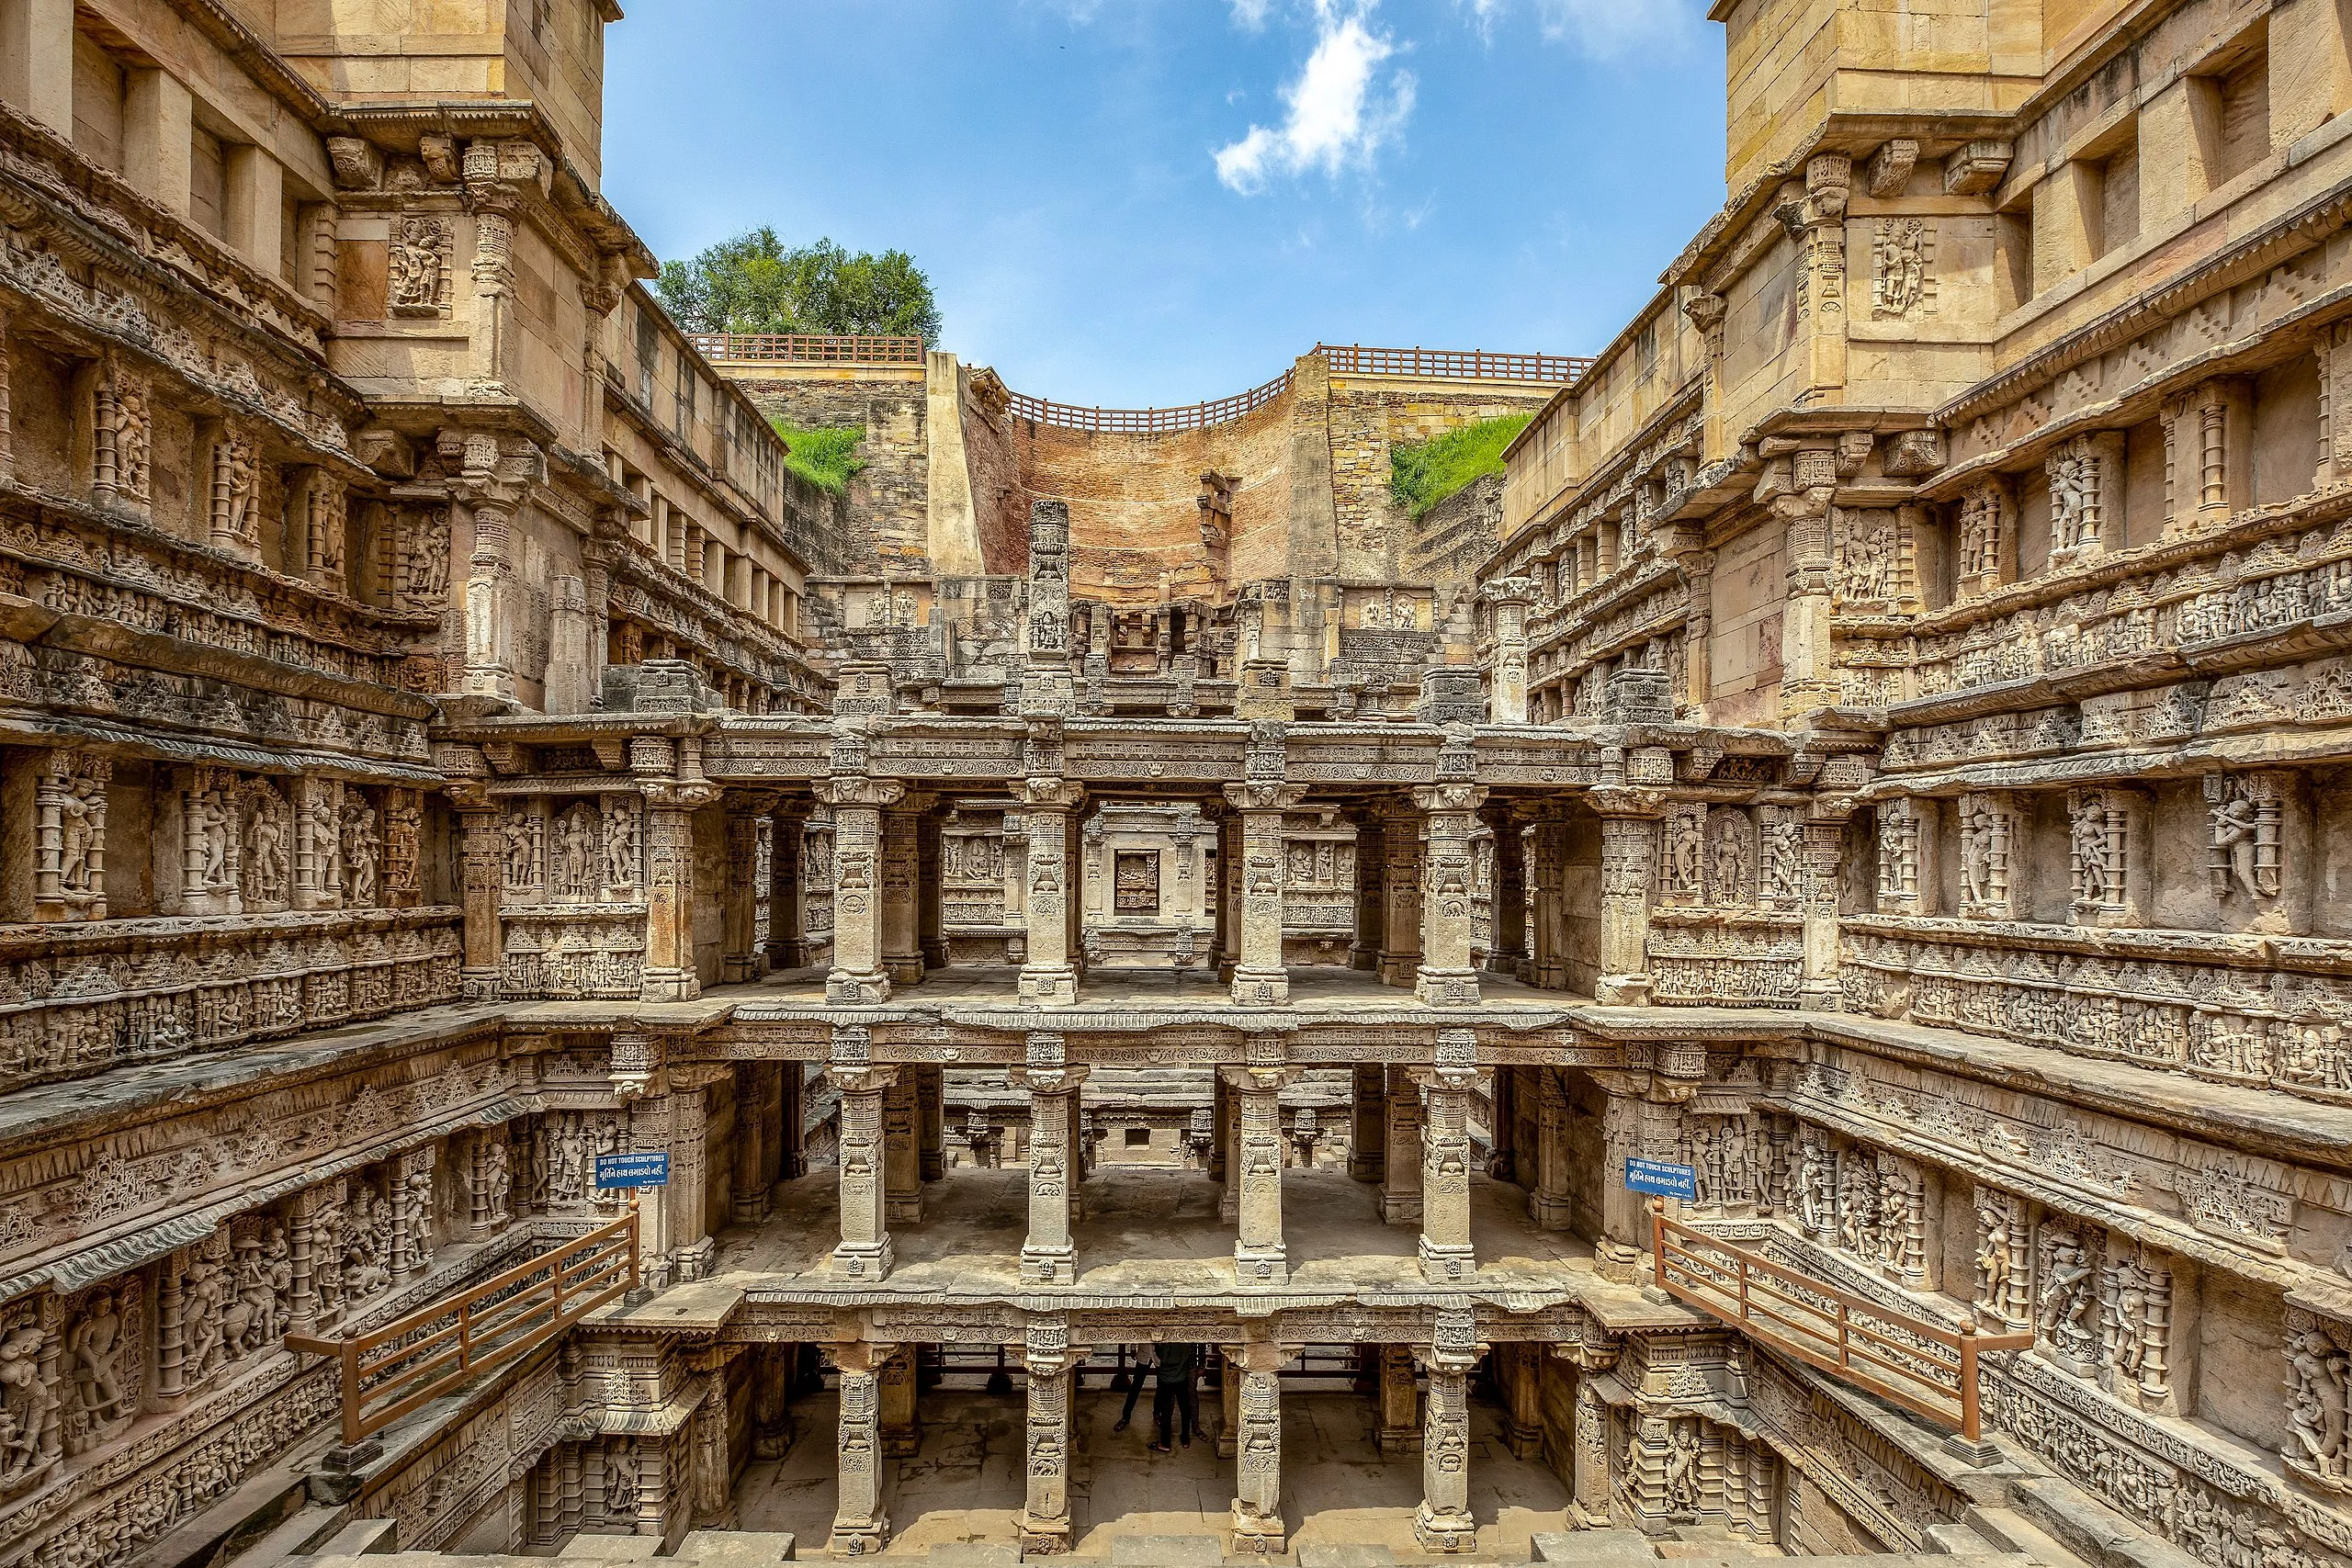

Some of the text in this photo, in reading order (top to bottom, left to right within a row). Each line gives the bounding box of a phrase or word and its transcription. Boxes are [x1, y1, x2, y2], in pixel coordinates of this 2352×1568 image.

[600, 1168, 616, 1181] મૂર્તિને
[616, 1169, 628, 1178] હાથ
[628, 1165, 650, 1176] લગાડવો
[1646, 1163, 1661, 1171] TOUCH
[1662, 1166, 1690, 1176] SCULPTURES
[1630, 1170, 1644, 1183] મૂર્તિને
[1645, 1175, 1655, 1183] હાથ
[1656, 1177, 1677, 1187] લગાડવો
